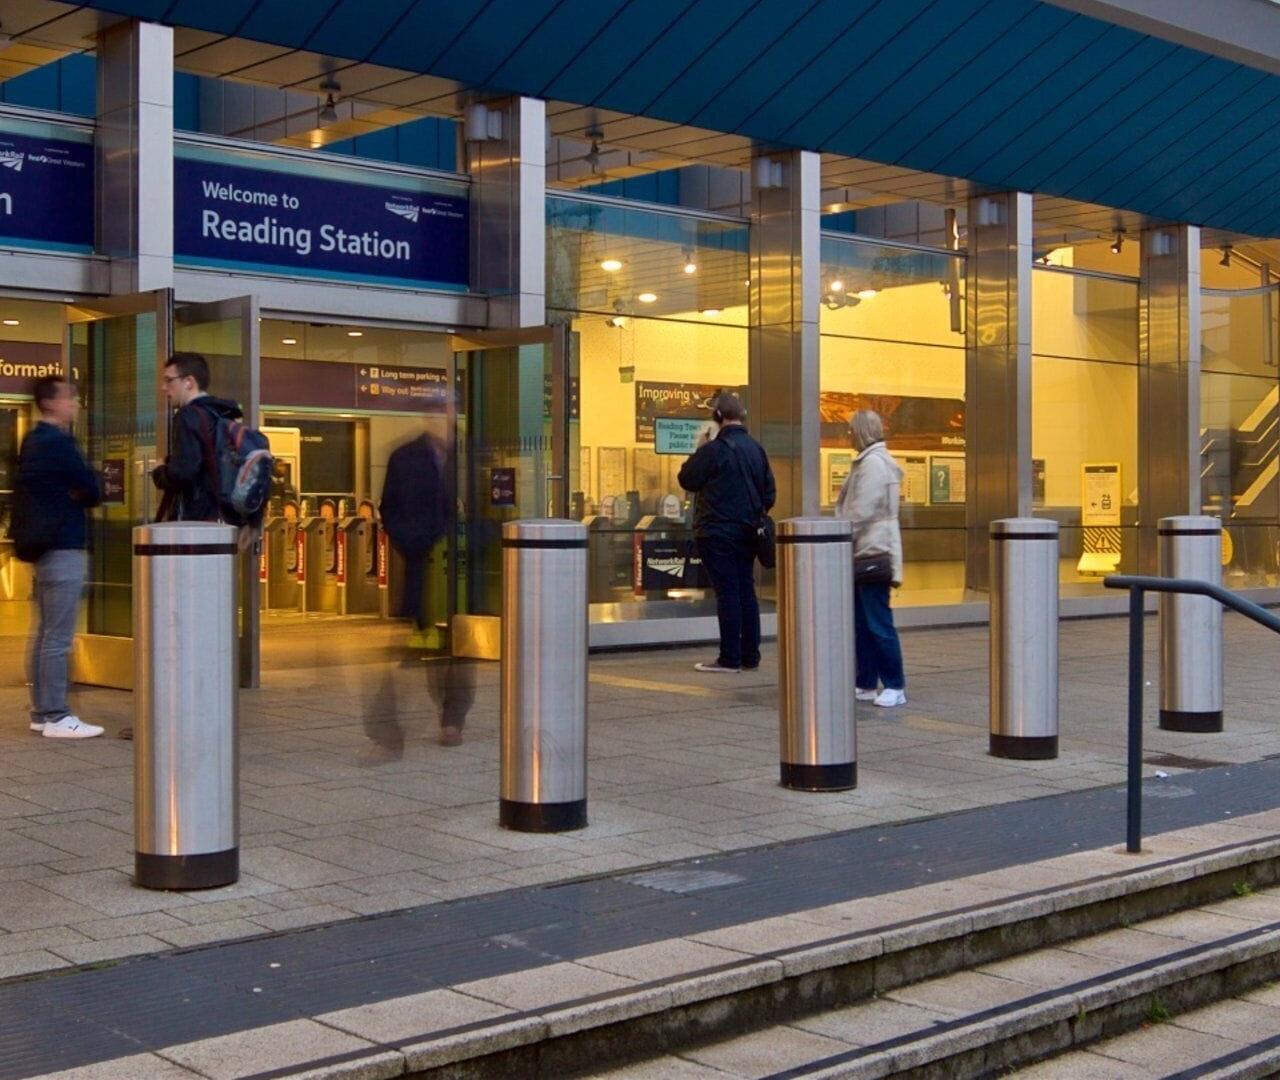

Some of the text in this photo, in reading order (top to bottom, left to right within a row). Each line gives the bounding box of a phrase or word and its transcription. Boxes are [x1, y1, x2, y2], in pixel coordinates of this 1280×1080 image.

[202, 180, 299, 209] Welcome to
[202, 209, 410, 260] Reading Station
[639, 383, 690, 403] Improving
